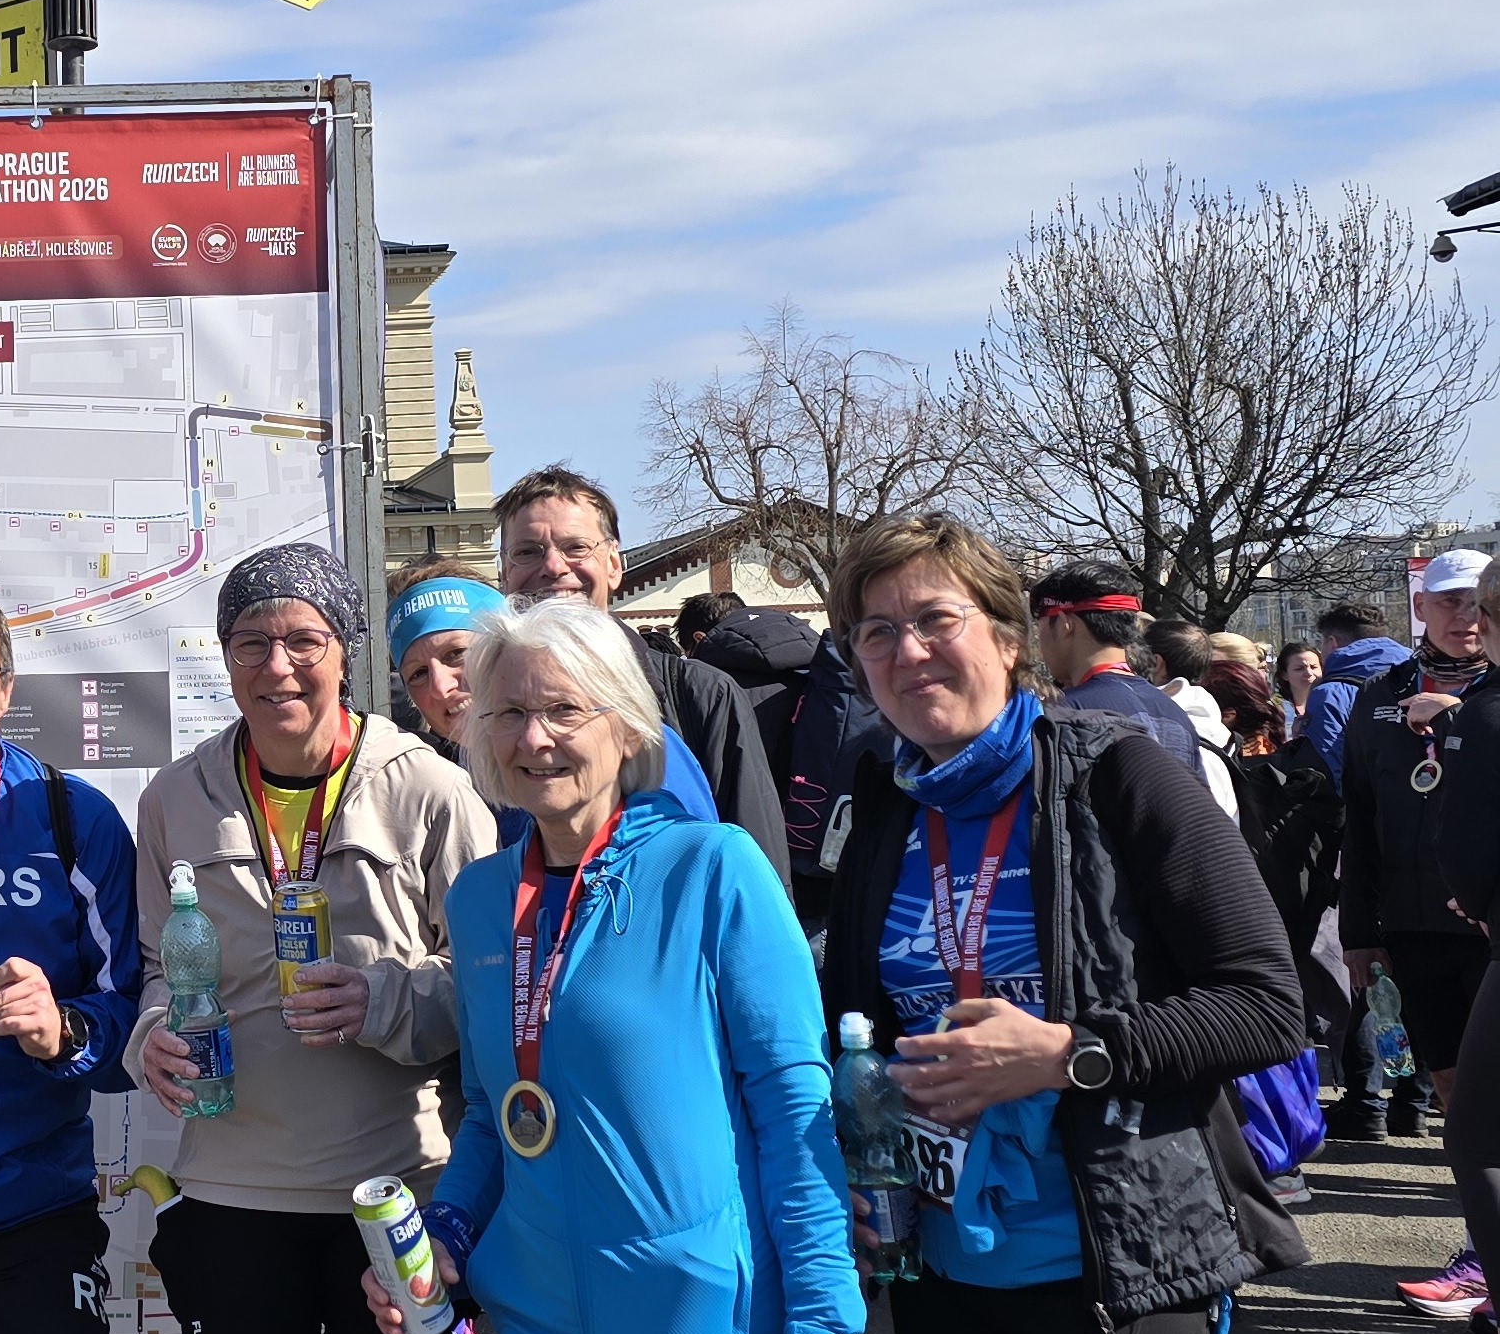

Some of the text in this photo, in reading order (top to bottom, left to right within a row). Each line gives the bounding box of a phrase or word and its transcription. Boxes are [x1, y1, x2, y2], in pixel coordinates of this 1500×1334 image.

[142, 161, 219, 184] RUNCZECH
[240, 153, 296, 171] ALL RUNNERS
[59, 177, 109, 202] 2026
[237, 169, 300, 187] ARE BEAUTIFUL
[45, 238, 113, 258] HOLEŠOVICE
[403, 589, 469, 618] BEAUTIFUL
[16, 645, 71, 663] Bubenské
[122, 627, 169, 643] Holešov
[300, 829, 320, 880] ALL RUNNERS
[963, 855, 1000, 972] ALL RUNNERS ARE BEAUTIFUL
[516, 935, 533, 949] ALL
[514, 948, 530, 987] RUNNERS
[514, 987, 529, 1005] ARE
[527, 986, 546, 1026] RUNNERS
[524, 1026, 538, 1042] ALL
